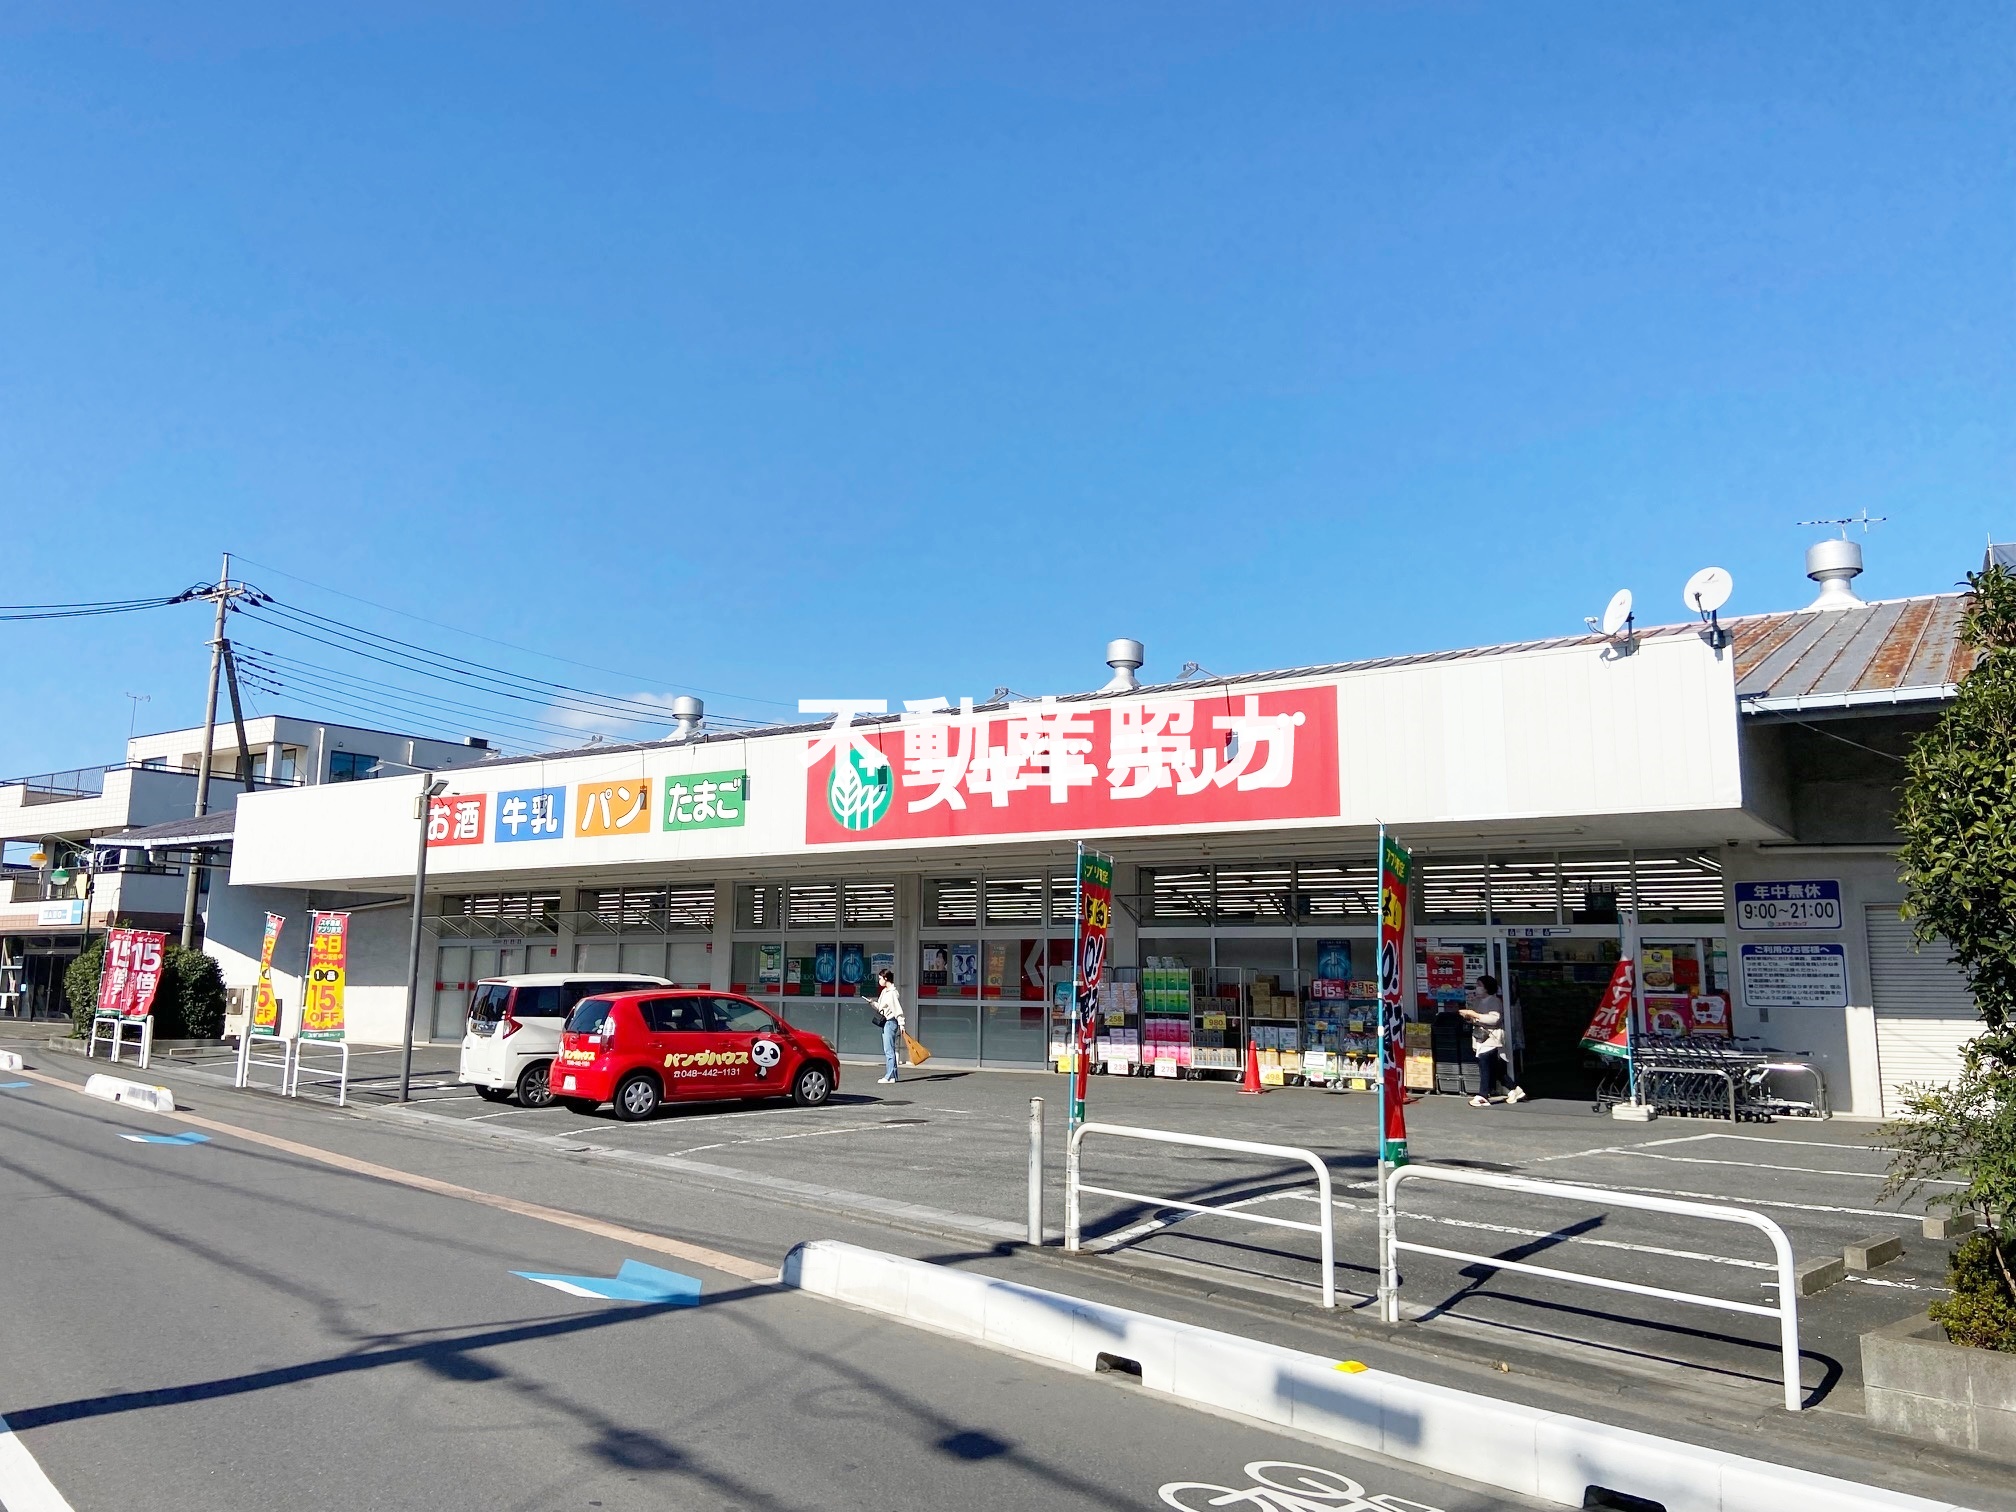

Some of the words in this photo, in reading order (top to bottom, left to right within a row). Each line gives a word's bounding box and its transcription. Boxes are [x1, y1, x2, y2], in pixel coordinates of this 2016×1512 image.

[581, 787, 647, 831] パン
[668, 778, 741, 824] たまご
[427, 801, 482, 841] お酒
[501, 792, 559, 836] 牛乳
[1753, 884, 1821, 899] 年中無休
[1744, 902, 1834, 920] 9:00~21:00
[314, 935, 342, 953] 本日
[1754, 946, 1830, 954] ご利用のお客様へ
[131, 942, 162, 972] 15
[136, 971, 156, 1012] 倍デー
[309, 1012, 339, 1022] OFF
[664, 1049, 749, 1068] パンダハウス
[680, 1068, 741, 1078] 048-442-1131
